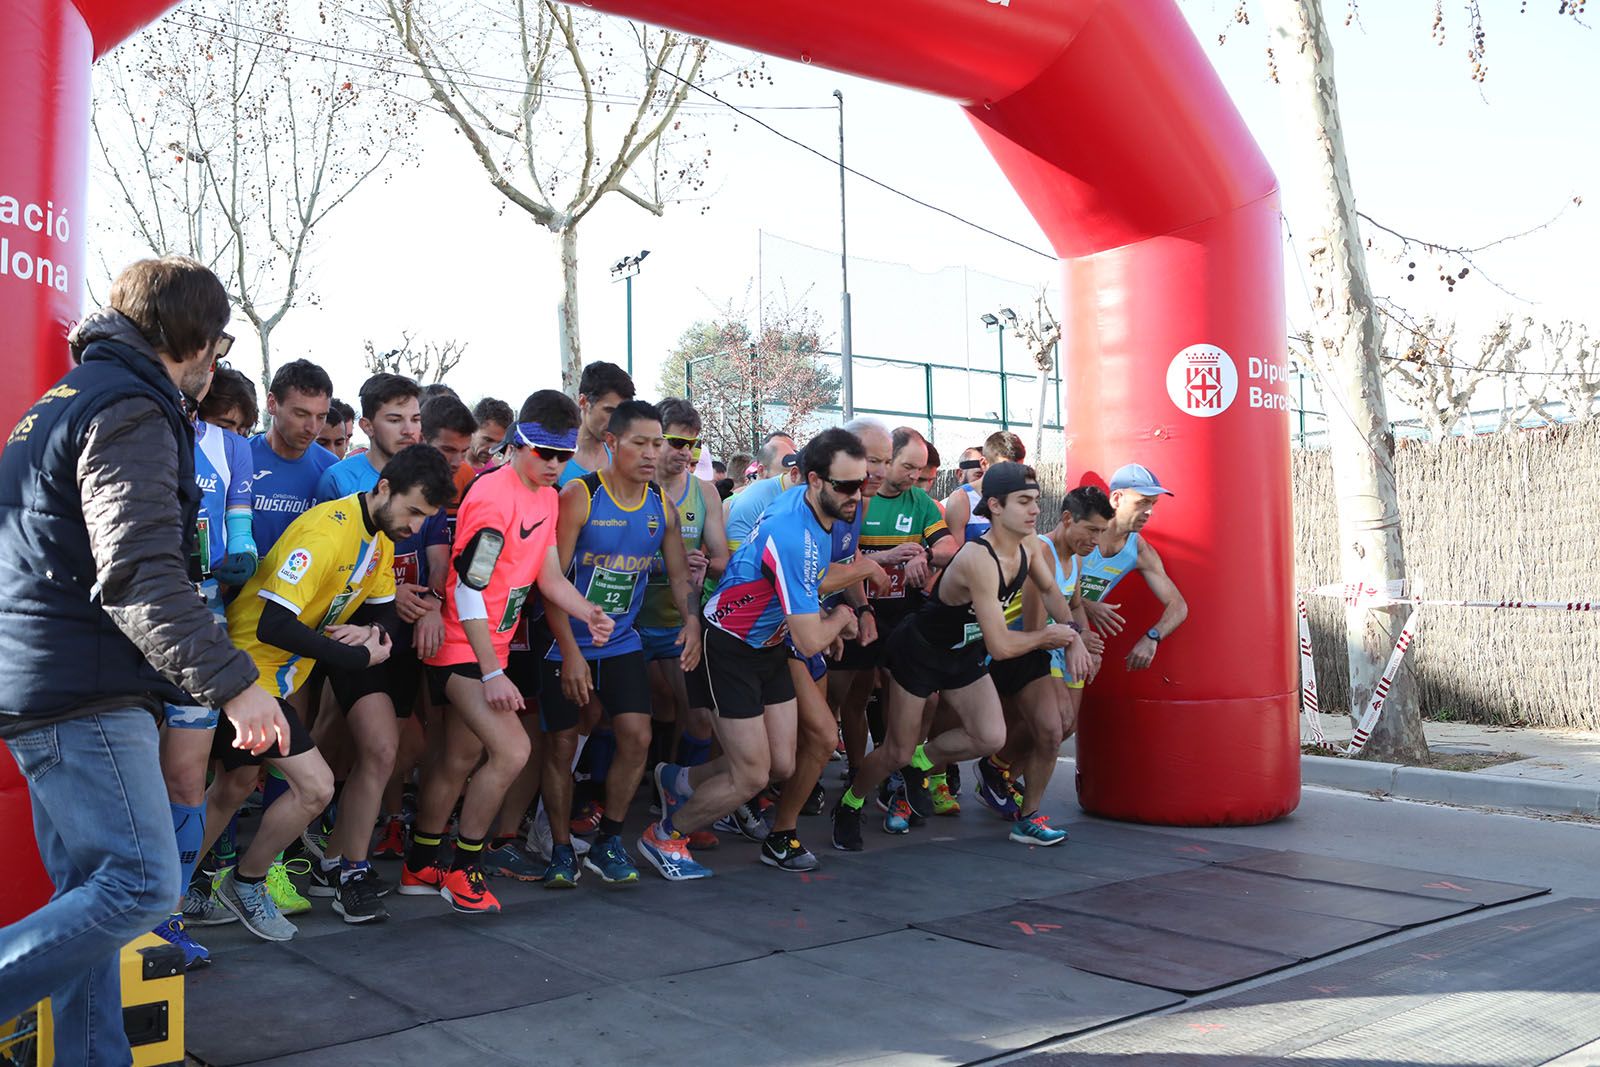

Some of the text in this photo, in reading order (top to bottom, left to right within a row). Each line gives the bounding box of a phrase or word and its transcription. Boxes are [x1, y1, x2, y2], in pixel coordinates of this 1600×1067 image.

[0, 195, 71, 243] ació
[0, 238, 69, 293] lona
[592, 519, 627, 528] marathon
[604, 592, 621, 604] 12
